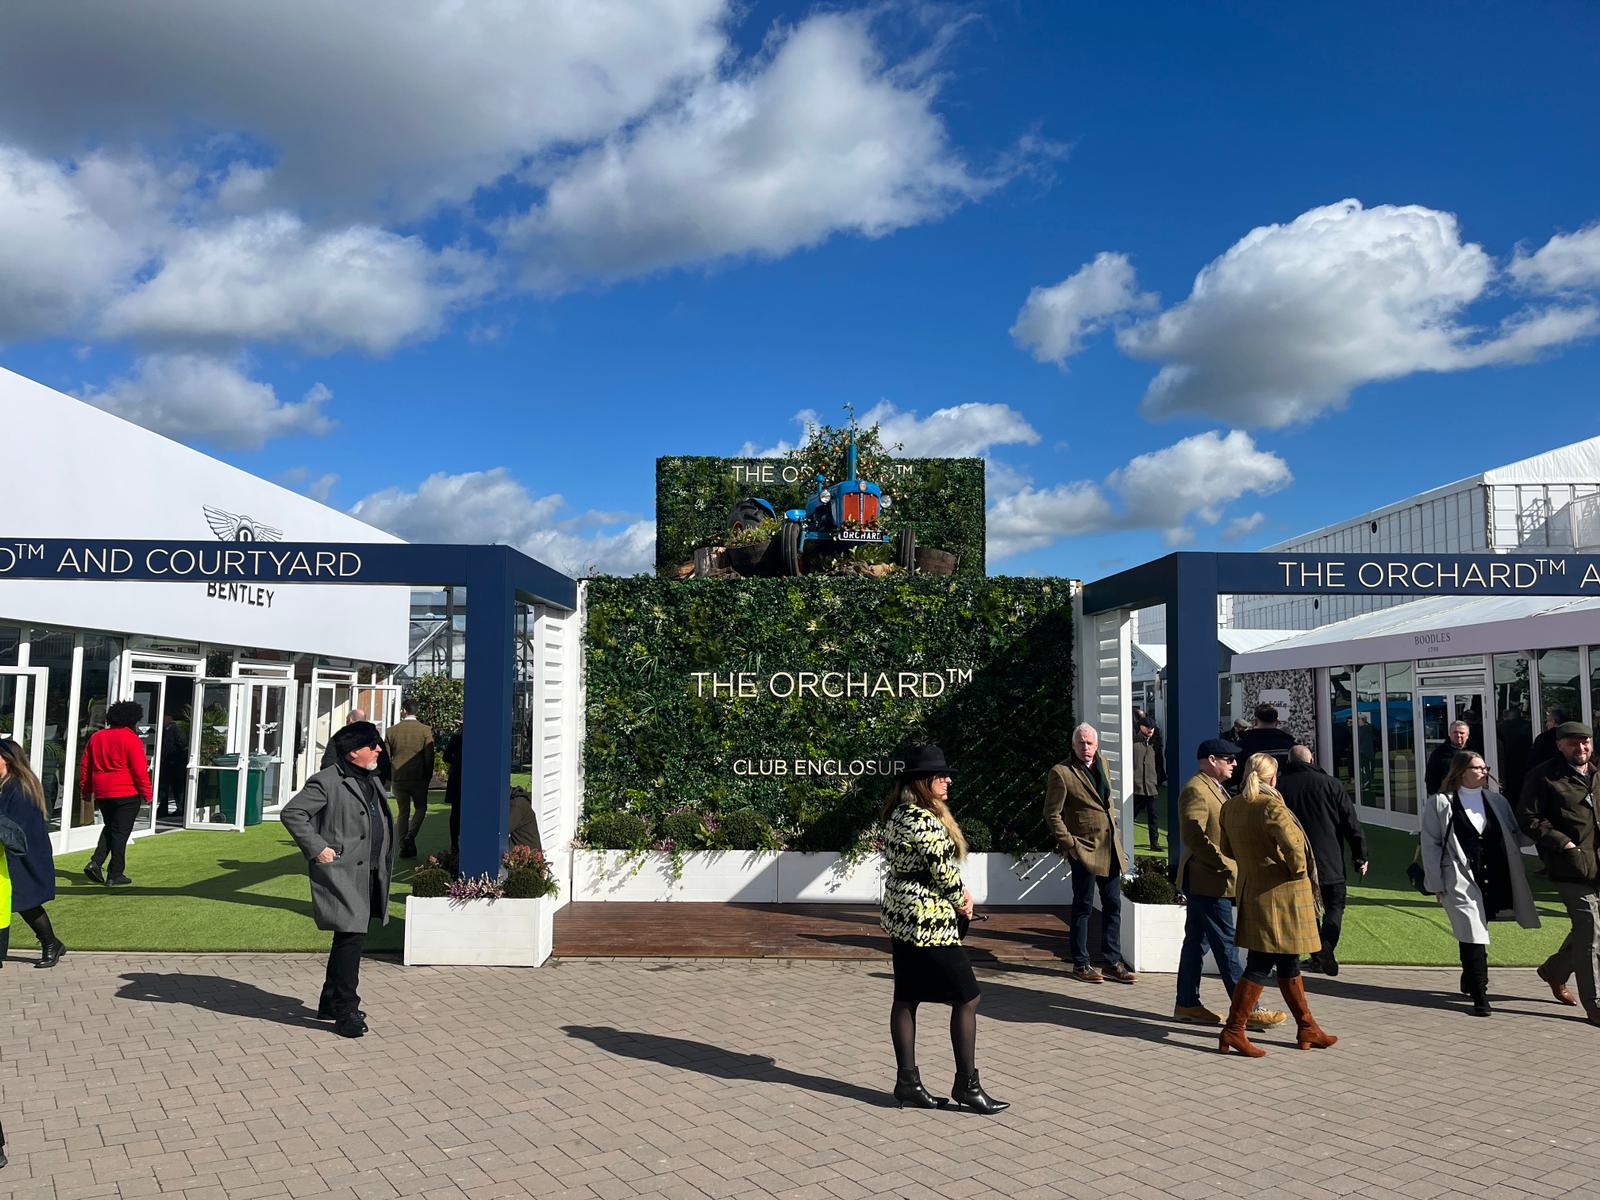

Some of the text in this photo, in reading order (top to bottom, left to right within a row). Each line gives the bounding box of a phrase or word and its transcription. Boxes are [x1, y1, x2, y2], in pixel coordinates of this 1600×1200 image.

[731, 465, 775, 483] THE
[56, 547, 134, 573] AND
[145, 548, 362, 577] COURTYARD
[1278, 562, 1345, 587] THE
[207, 582, 275, 608] BENTLEY
[1414, 632, 1451, 646] BOODLES
[690, 672, 757, 697] THE
[733, 759, 906, 776] CLUB ENCLOSUR
